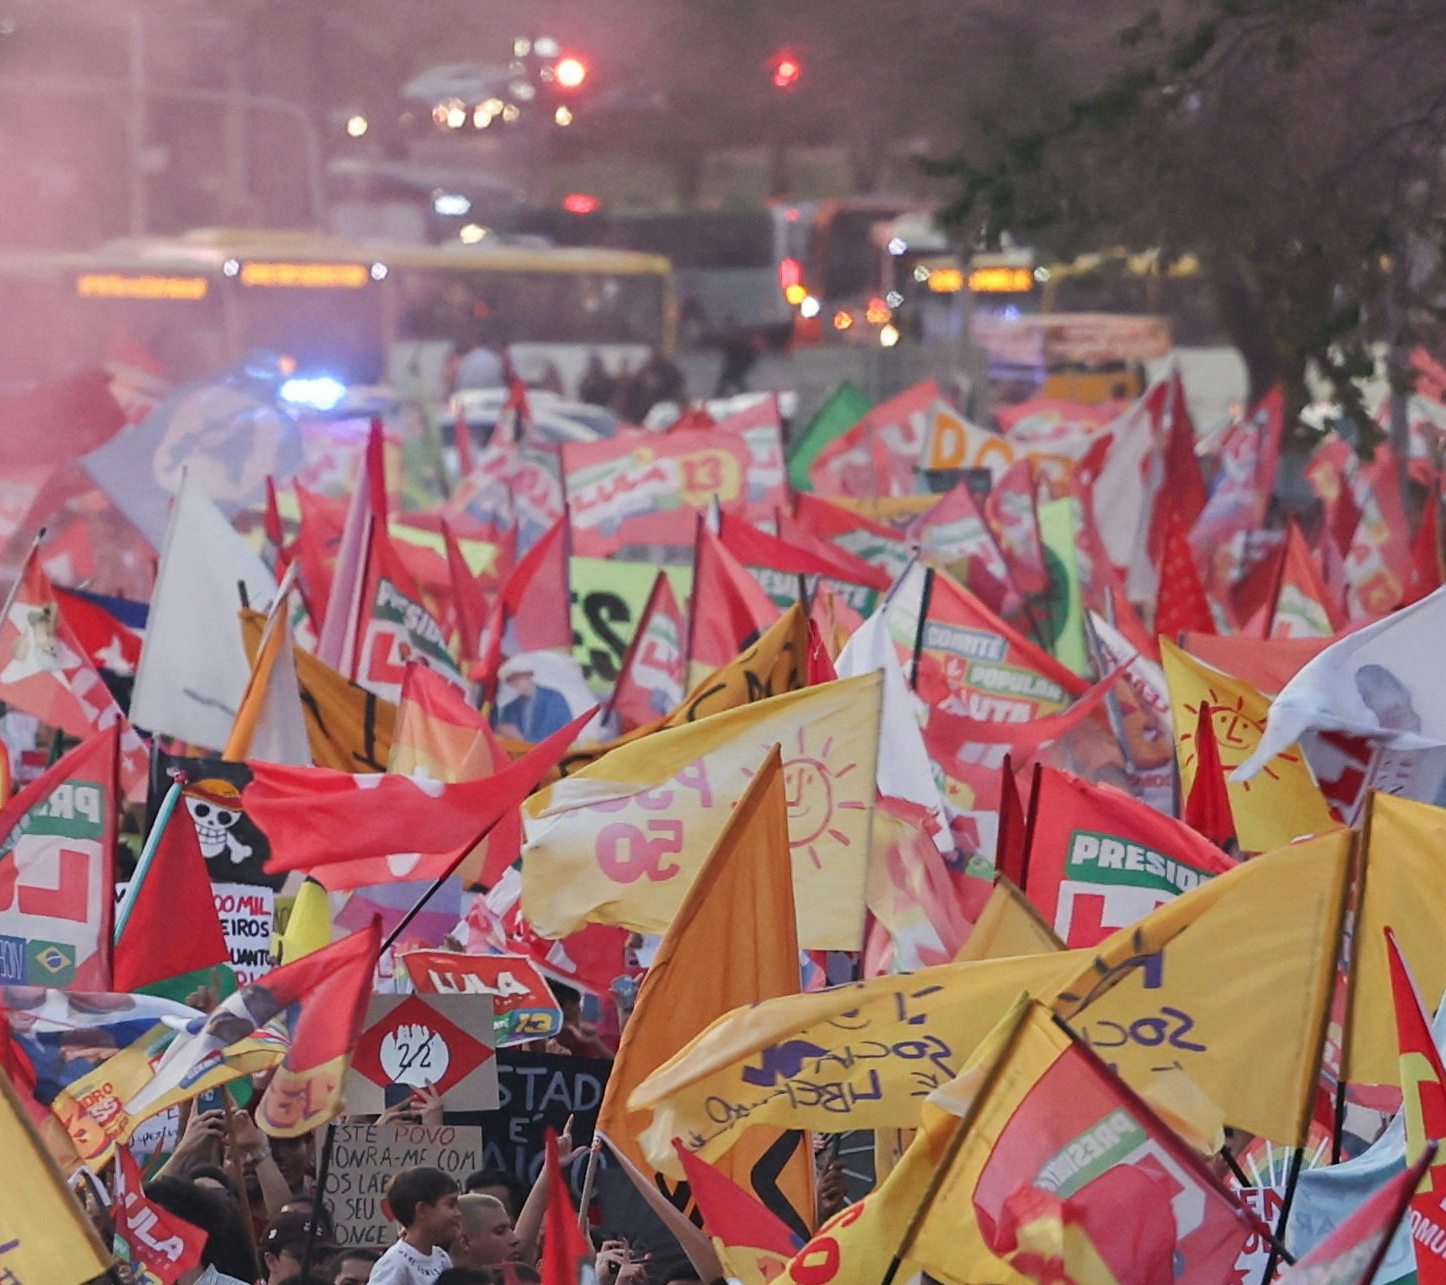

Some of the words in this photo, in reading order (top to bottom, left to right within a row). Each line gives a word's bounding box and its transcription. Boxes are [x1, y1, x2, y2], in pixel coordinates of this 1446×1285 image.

[681, 455, 724, 489] 13
[236, 896, 272, 916] MIL
[394, 1125, 457, 1146] POVO
[437, 1147, 477, 1173] COM
[345, 1198, 376, 1222] SEU
